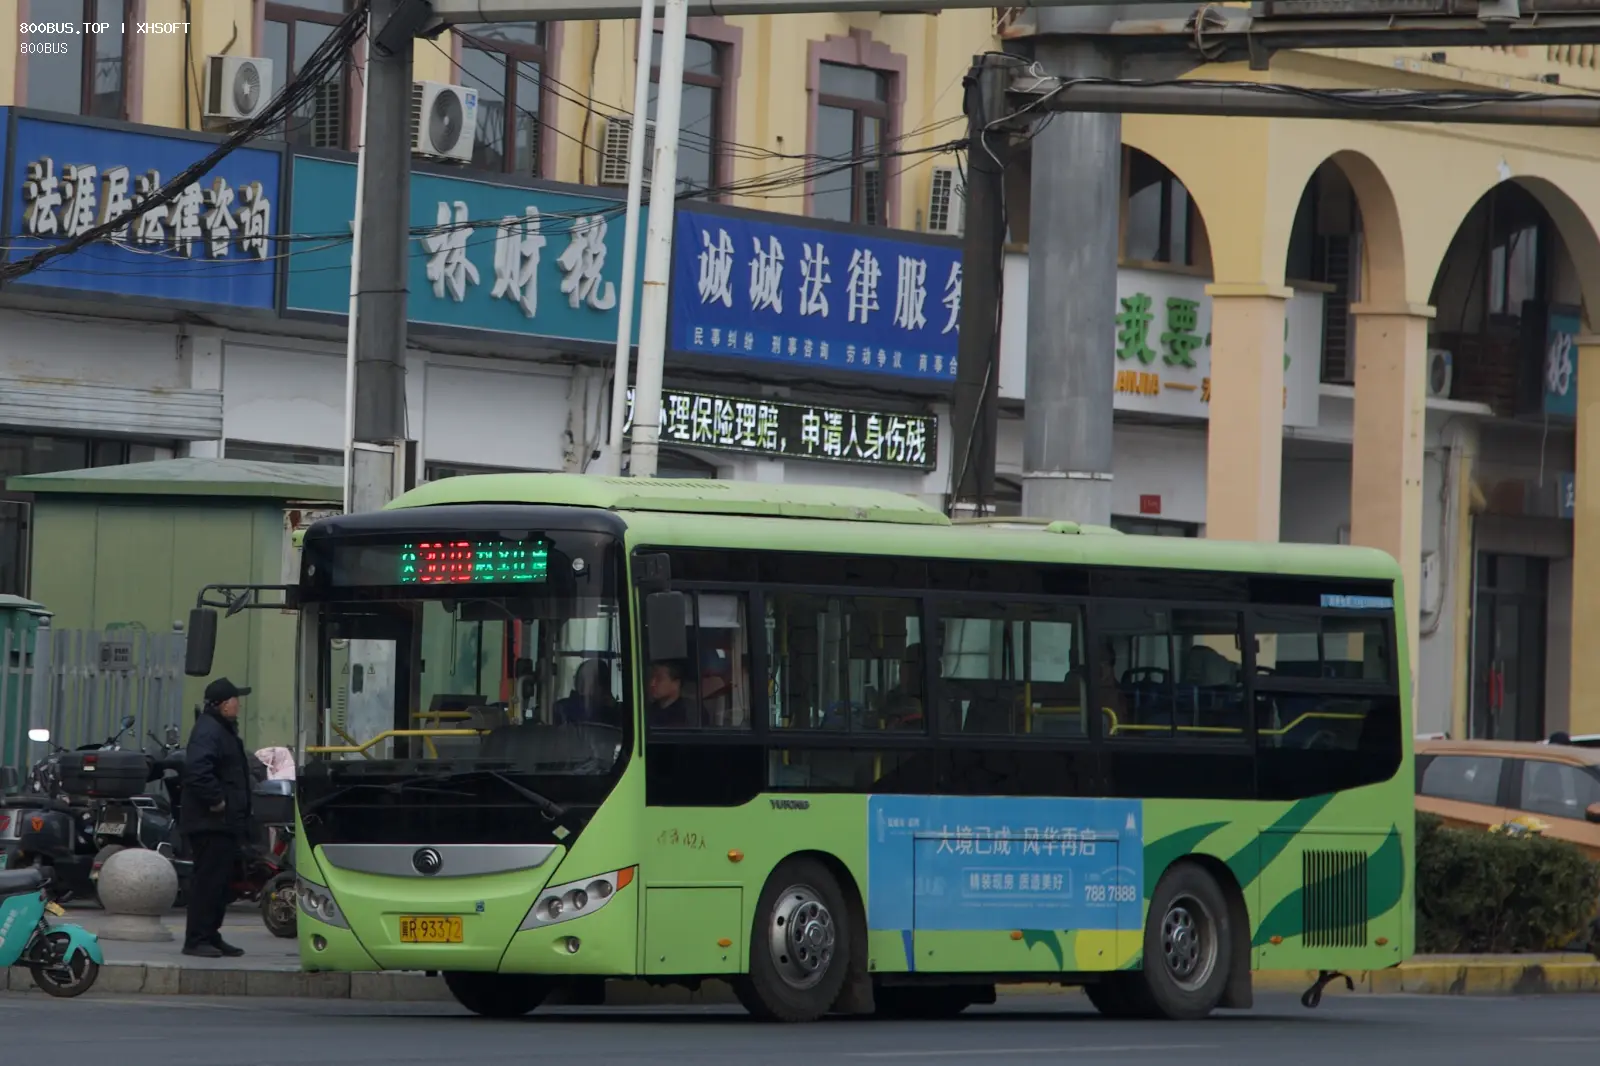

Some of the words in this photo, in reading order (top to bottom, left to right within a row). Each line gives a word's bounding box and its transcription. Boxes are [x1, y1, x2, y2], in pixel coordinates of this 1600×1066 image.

[23, 156, 271, 261] 法涯居法律咨询
[349, 201, 616, 318] 林财税
[693, 327, 754, 351] 民事纠纷
[771, 336, 830, 360] 刑事咨询
[846, 345, 902, 369] 劳动争议
[1115, 293, 1212, 371] 我要
[622, 390, 926, 464] 理保险理赔，申请人身伤残
[1022, 827, 1096, 857] 风华再启
[1084, 885, 1106, 902] 788
[1108, 885, 1136, 902] 7888
